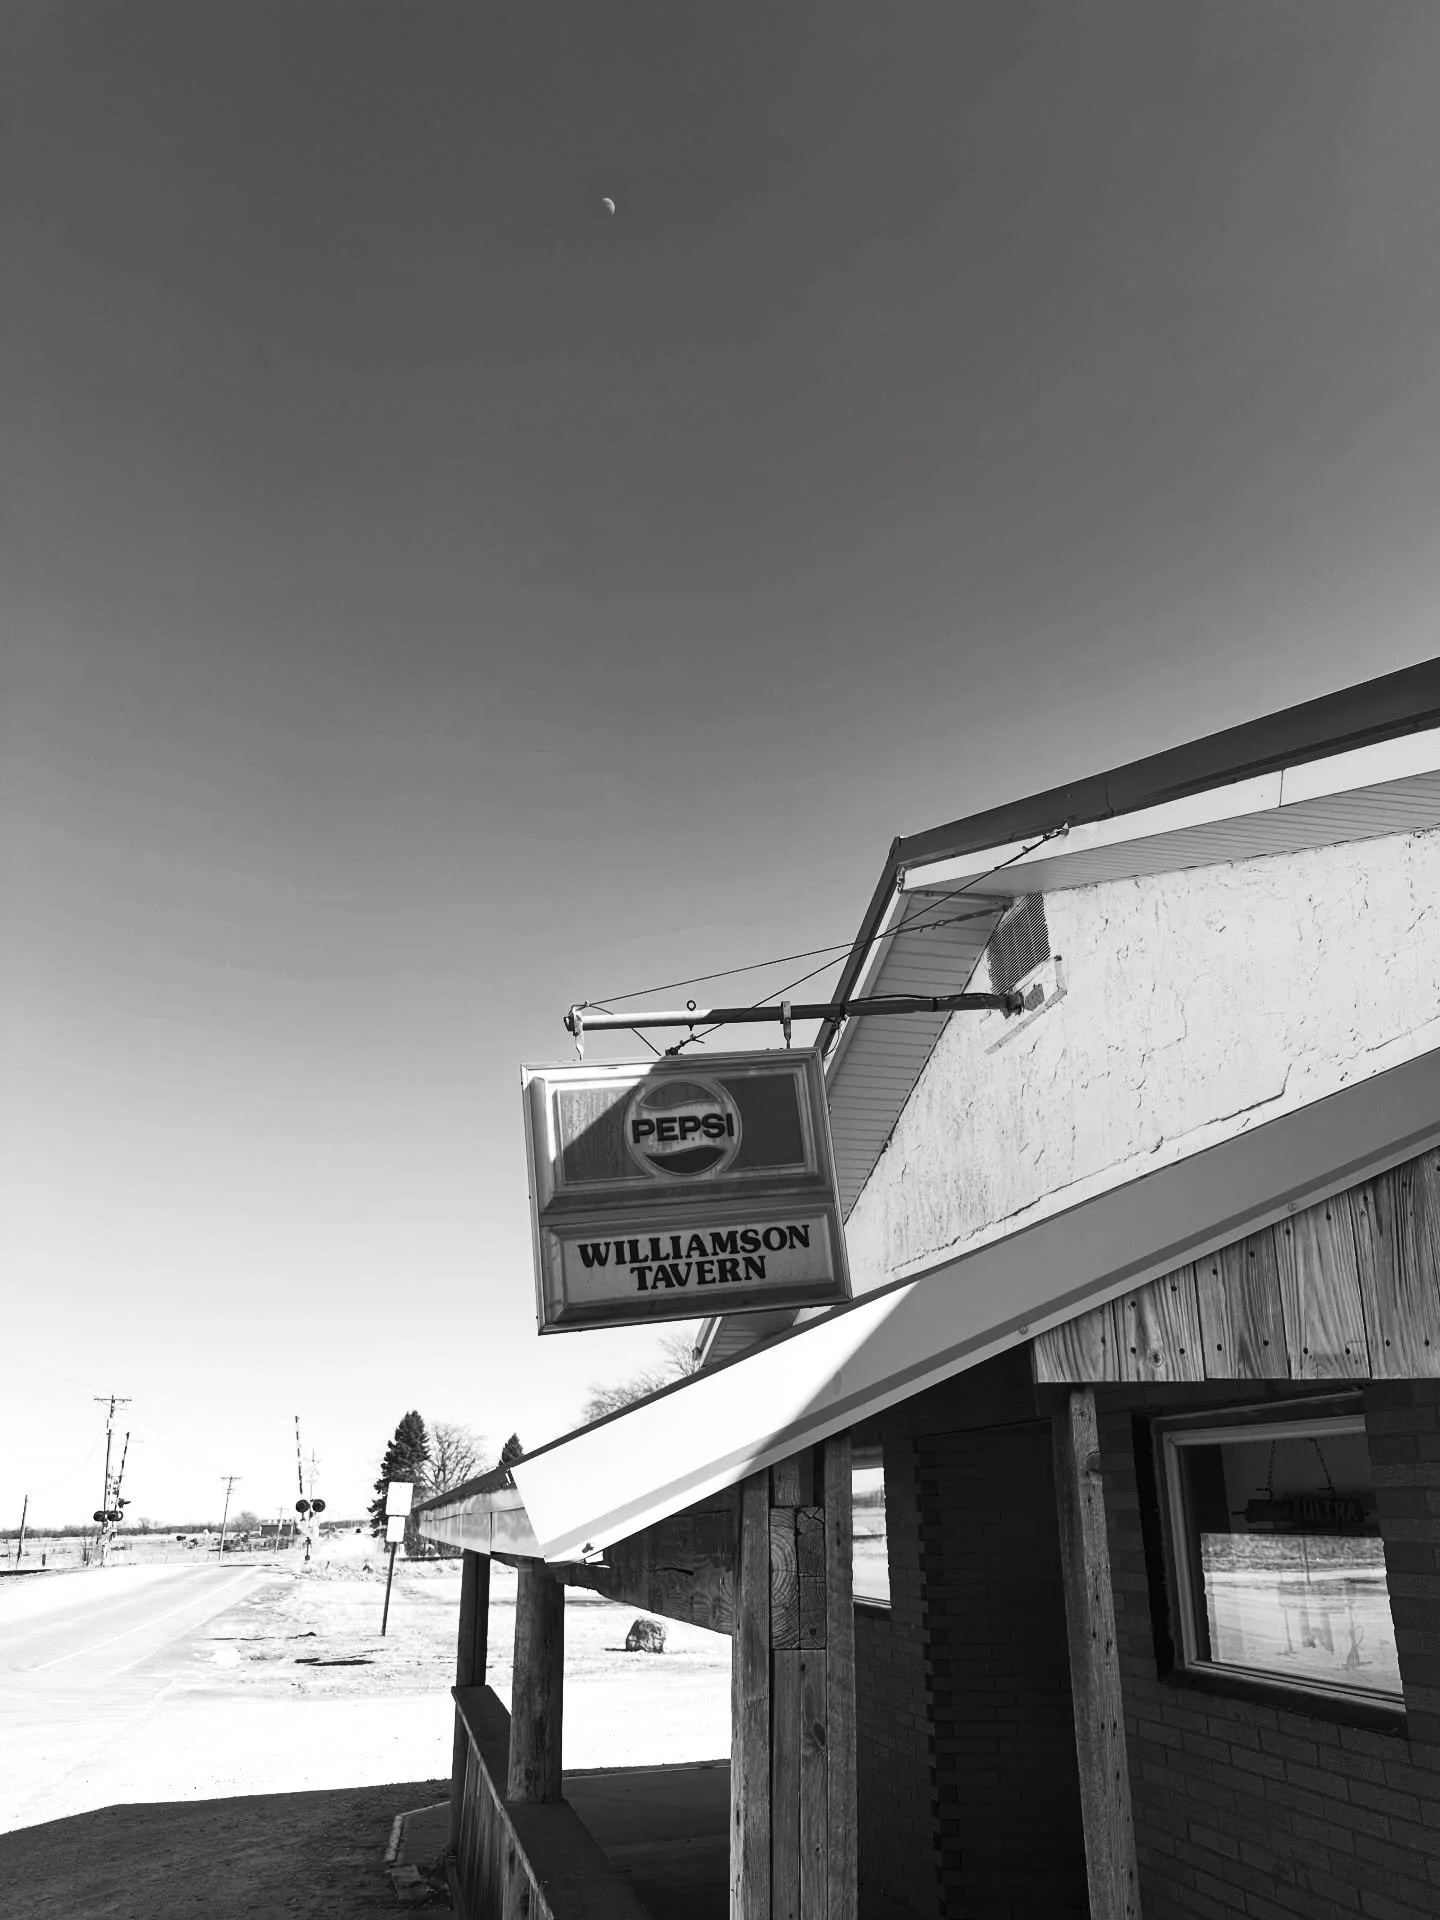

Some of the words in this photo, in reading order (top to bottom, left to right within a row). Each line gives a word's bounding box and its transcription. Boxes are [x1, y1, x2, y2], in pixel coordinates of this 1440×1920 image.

[631, 1112, 735, 1144] PEPSI
[577, 1224, 811, 1268] WILLIAMSON
[630, 1255, 767, 1291] TAVERN
